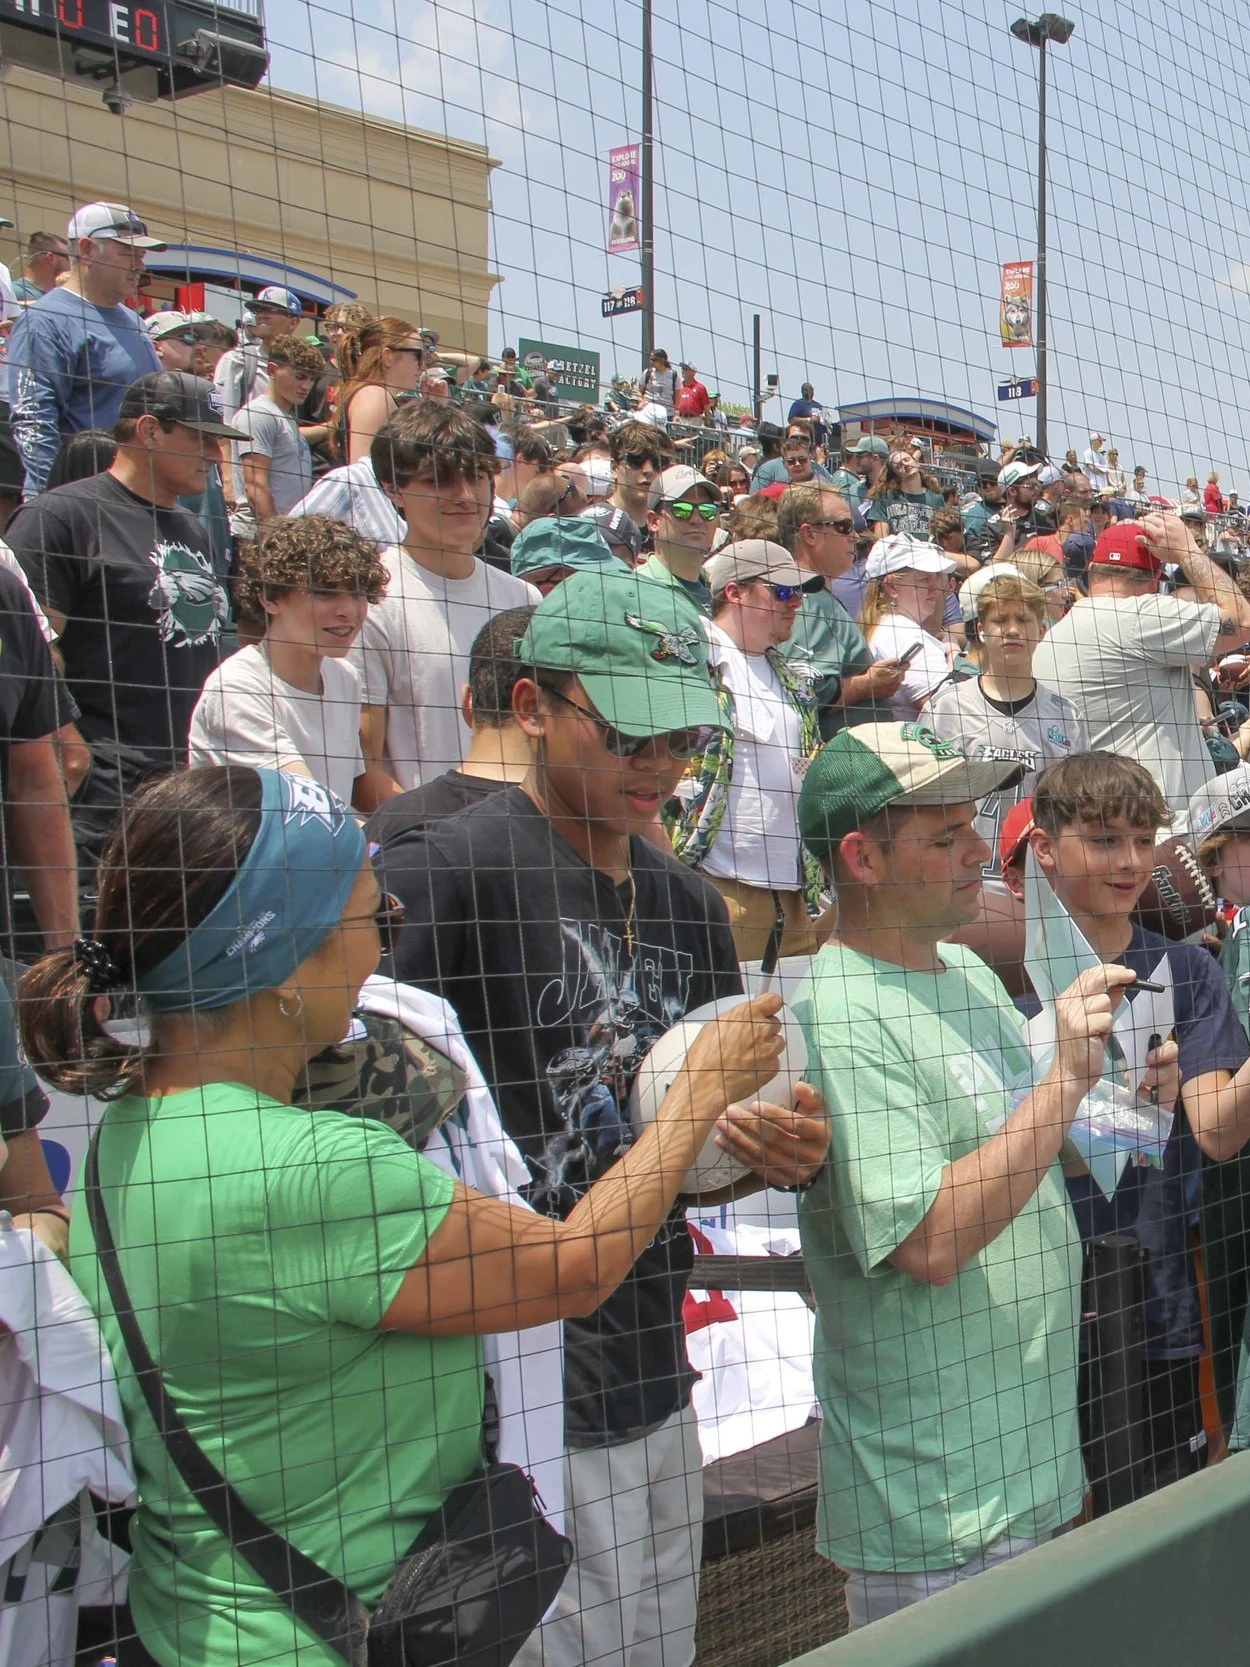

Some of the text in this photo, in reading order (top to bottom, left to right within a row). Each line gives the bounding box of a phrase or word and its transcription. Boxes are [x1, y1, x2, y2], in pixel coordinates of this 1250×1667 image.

[109, 2, 130, 43] E
[134, 8, 158, 51] 0
[604, 301, 615, 312] 117
[557, 374, 597, 389] ACTORY
[1008, 386, 1022, 398] 118
[979, 744, 1041, 772] EAGLES
[226, 911, 276, 957] CHAMPIONS
